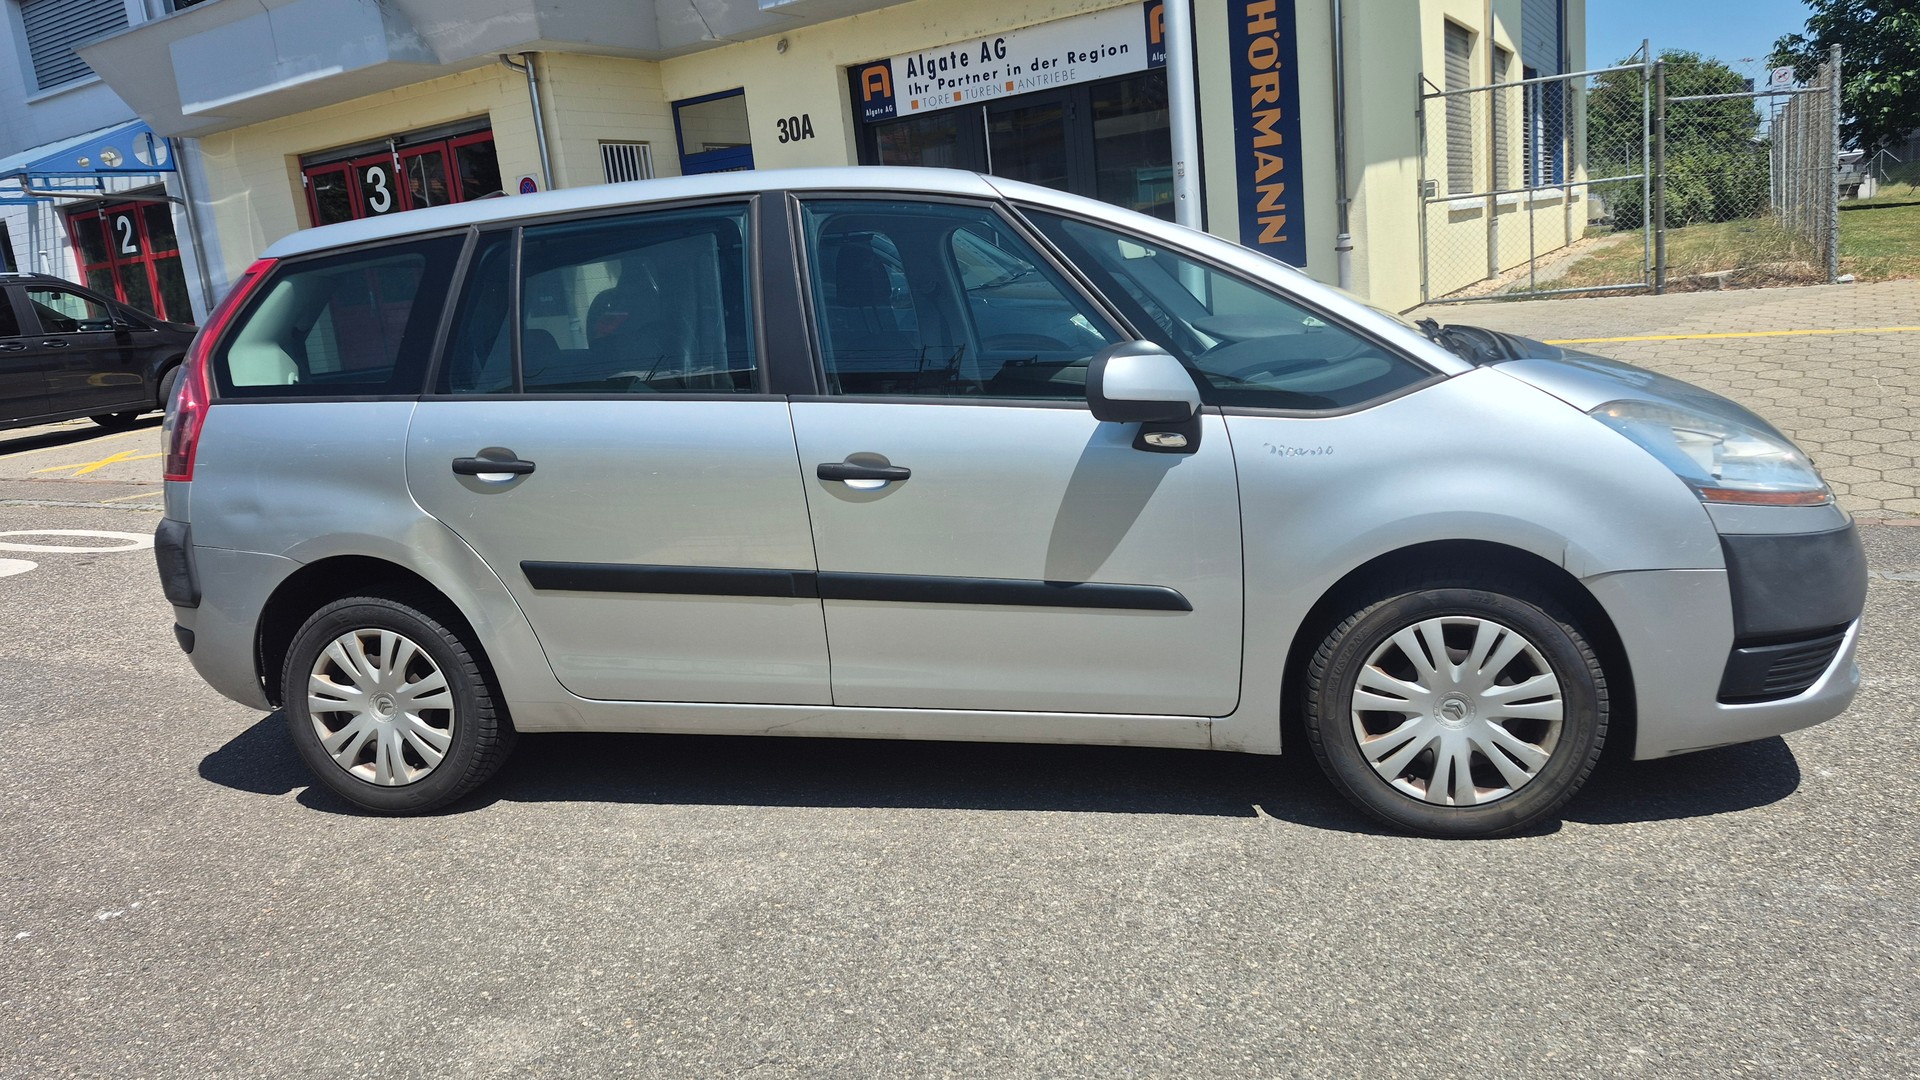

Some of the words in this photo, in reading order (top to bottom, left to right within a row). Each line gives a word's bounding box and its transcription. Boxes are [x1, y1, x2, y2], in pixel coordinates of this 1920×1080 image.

[907, 50, 969, 80] Algate
[980, 37, 1007, 64] AG
[908, 83, 930, 96] Ihr
[938, 70, 998, 90] Partner
[1006, 63, 1021, 77] in
[1030, 57, 1058, 72] der
[1067, 43, 1129, 64] Region
[922, 93, 950, 108] TORE
[964, 84, 1002, 100] TÜREN
[1017, 68, 1076, 90] ANTRIEBE
[776, 113, 815, 144] 30A
[865, 107, 884, 117] Algate
[884, 104, 894, 113] AG
[1246, 0, 1287, 244] HÖRMANN
[366, 166, 391, 213] 3
[116, 215, 137, 254] 2
